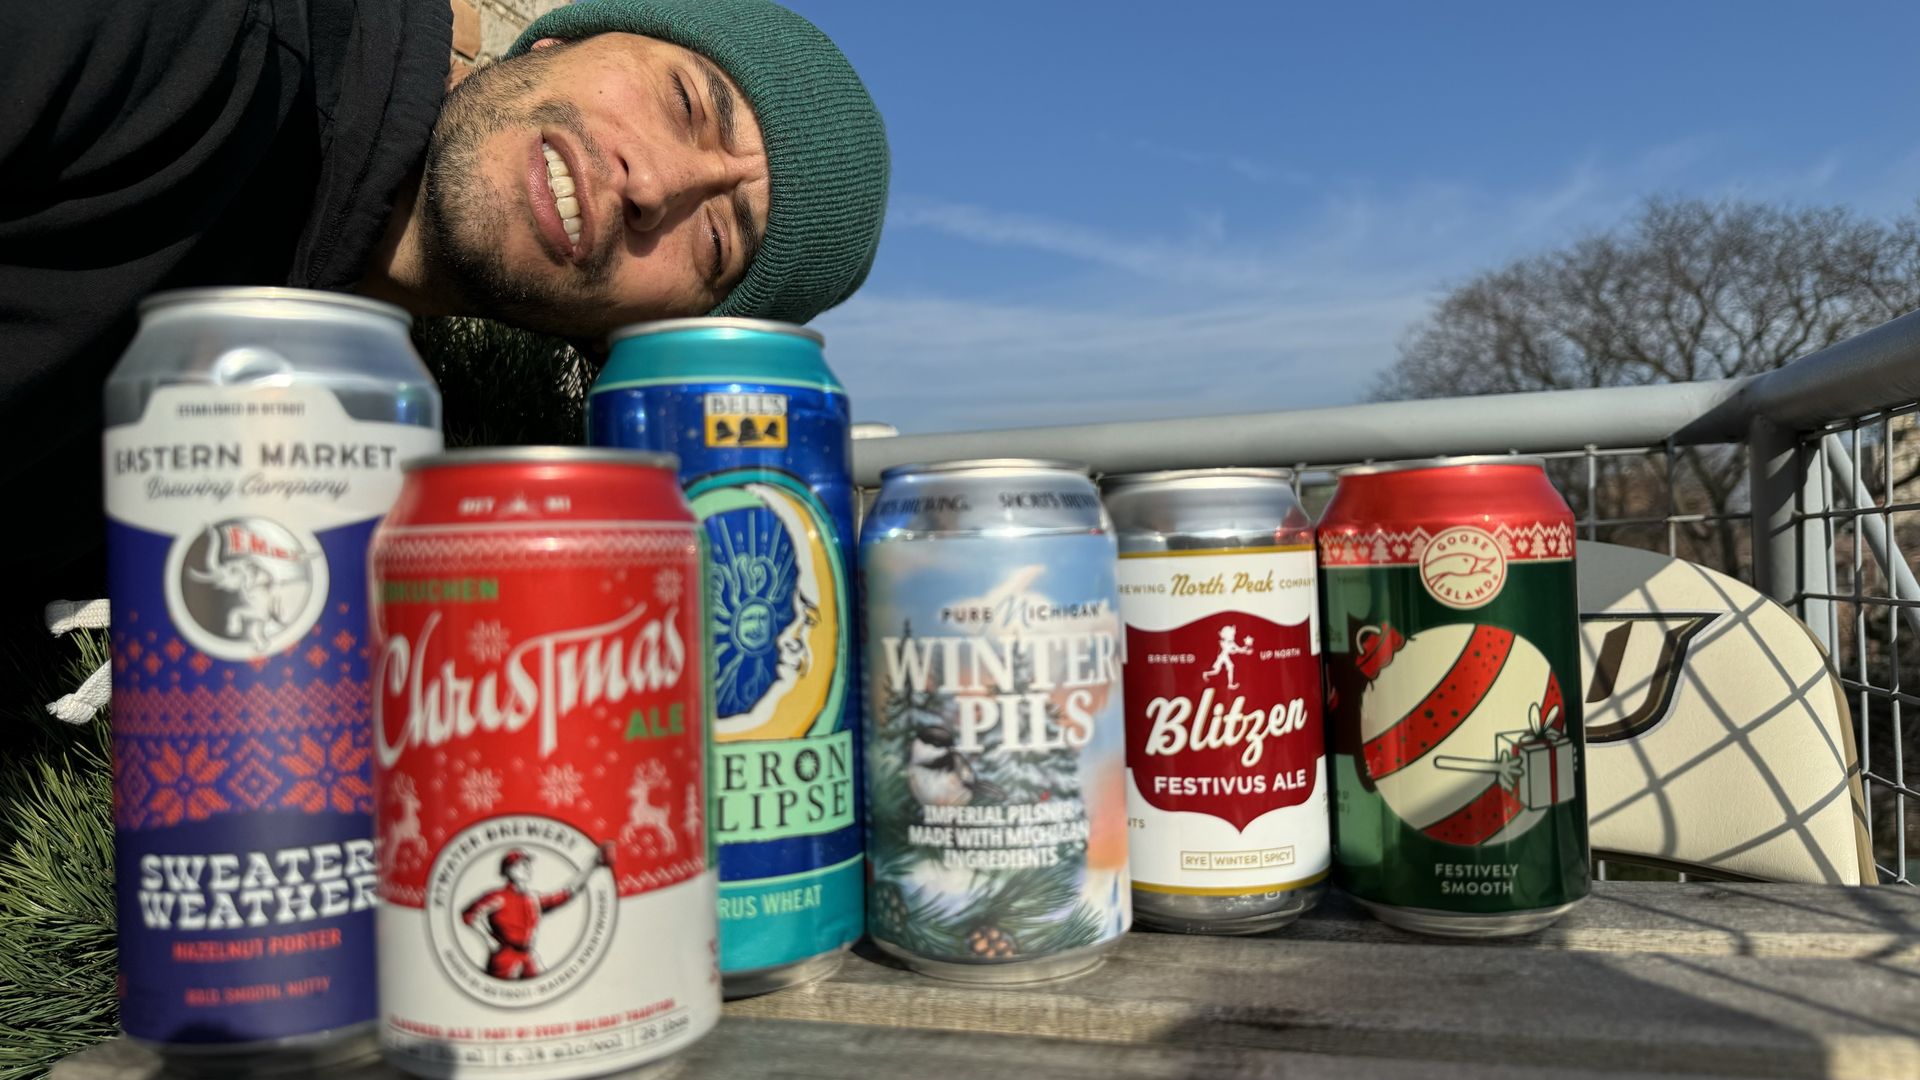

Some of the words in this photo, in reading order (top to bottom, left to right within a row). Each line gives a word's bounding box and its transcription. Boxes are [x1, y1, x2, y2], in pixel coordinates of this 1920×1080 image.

[114, 443, 243, 475] EASTERN
[261, 442, 397, 470] MARKET
[147, 475, 232, 502] Brewing
[238, 471, 349, 500] Company
[1436, 533, 1490, 552] GOOSE
[1171, 573, 1225, 597] North
[1231, 570, 1274, 593] Peak
[1437, 579, 1494, 601] ISLAND
[940, 605, 993, 624] PURE
[880, 632, 1117, 693] WINTER
[1147, 653, 1196, 664] BREWED
[1259, 650, 1273, 661] UP
[1274, 647, 1301, 660] NORTH
[624, 702, 686, 741] ALE
[954, 690, 1096, 752] PILS
[1145, 688, 1308, 767] Blitzen
[1154, 775, 1267, 795] FESTIVUS
[1273, 769, 1307, 790] ALE
[923, 804, 1005, 825] IMPERIAL
[486, 821, 577, 849] BREWERY
[908, 825, 954, 847] MADE
[955, 827, 1001, 848] WITH
[140, 839, 377, 892] SWEATER
[943, 848, 1059, 869] INGREDIENTS
[1185, 855, 1207, 866] RYE
[1214, 855, 1258, 866] WINTER
[1263, 851, 1291, 863] SPICY
[1435, 863, 1519, 878] FESTIVELY
[762, 884, 823, 915] WHEAT
[1440, 880, 1514, 894] SMOOTH
[138, 874, 379, 930] WEATHER
[172, 938, 265, 962] HAZELNUT
[267, 928, 342, 956] PORTER
